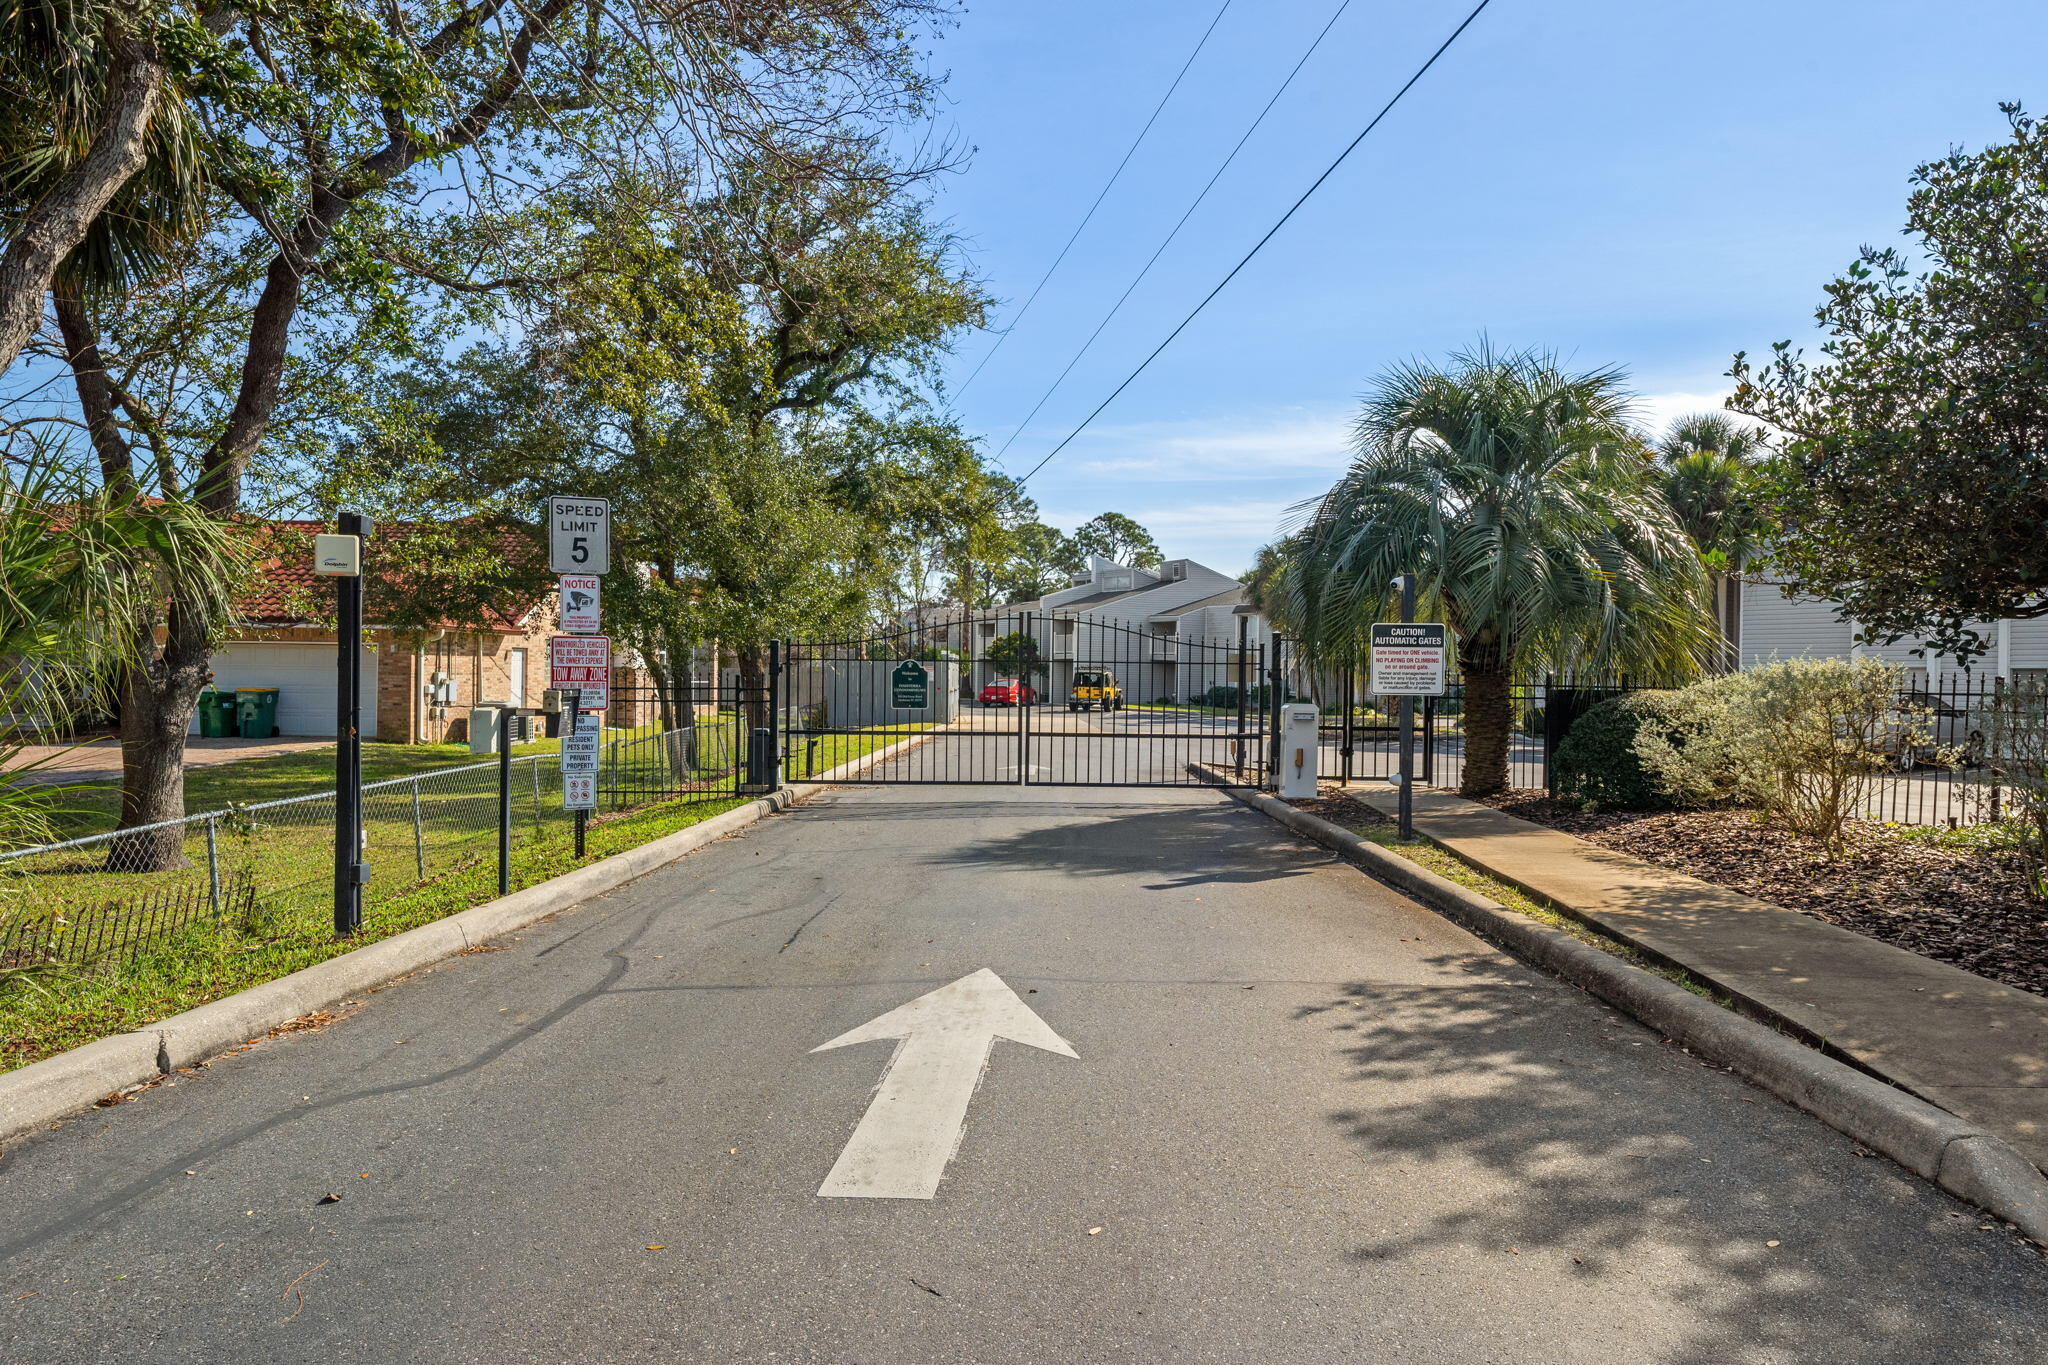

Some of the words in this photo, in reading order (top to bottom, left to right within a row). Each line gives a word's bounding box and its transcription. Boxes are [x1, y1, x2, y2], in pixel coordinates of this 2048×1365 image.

[556, 504, 603, 516] SPEED
[561, 521, 598, 532] LIMIT
[572, 537, 589, 563] 5
[565, 580, 596, 589] NOTICE
[553, 667, 568, 680] TOW
[570, 667, 587, 680] AWAY
[590, 668, 606, 680] ZONE
